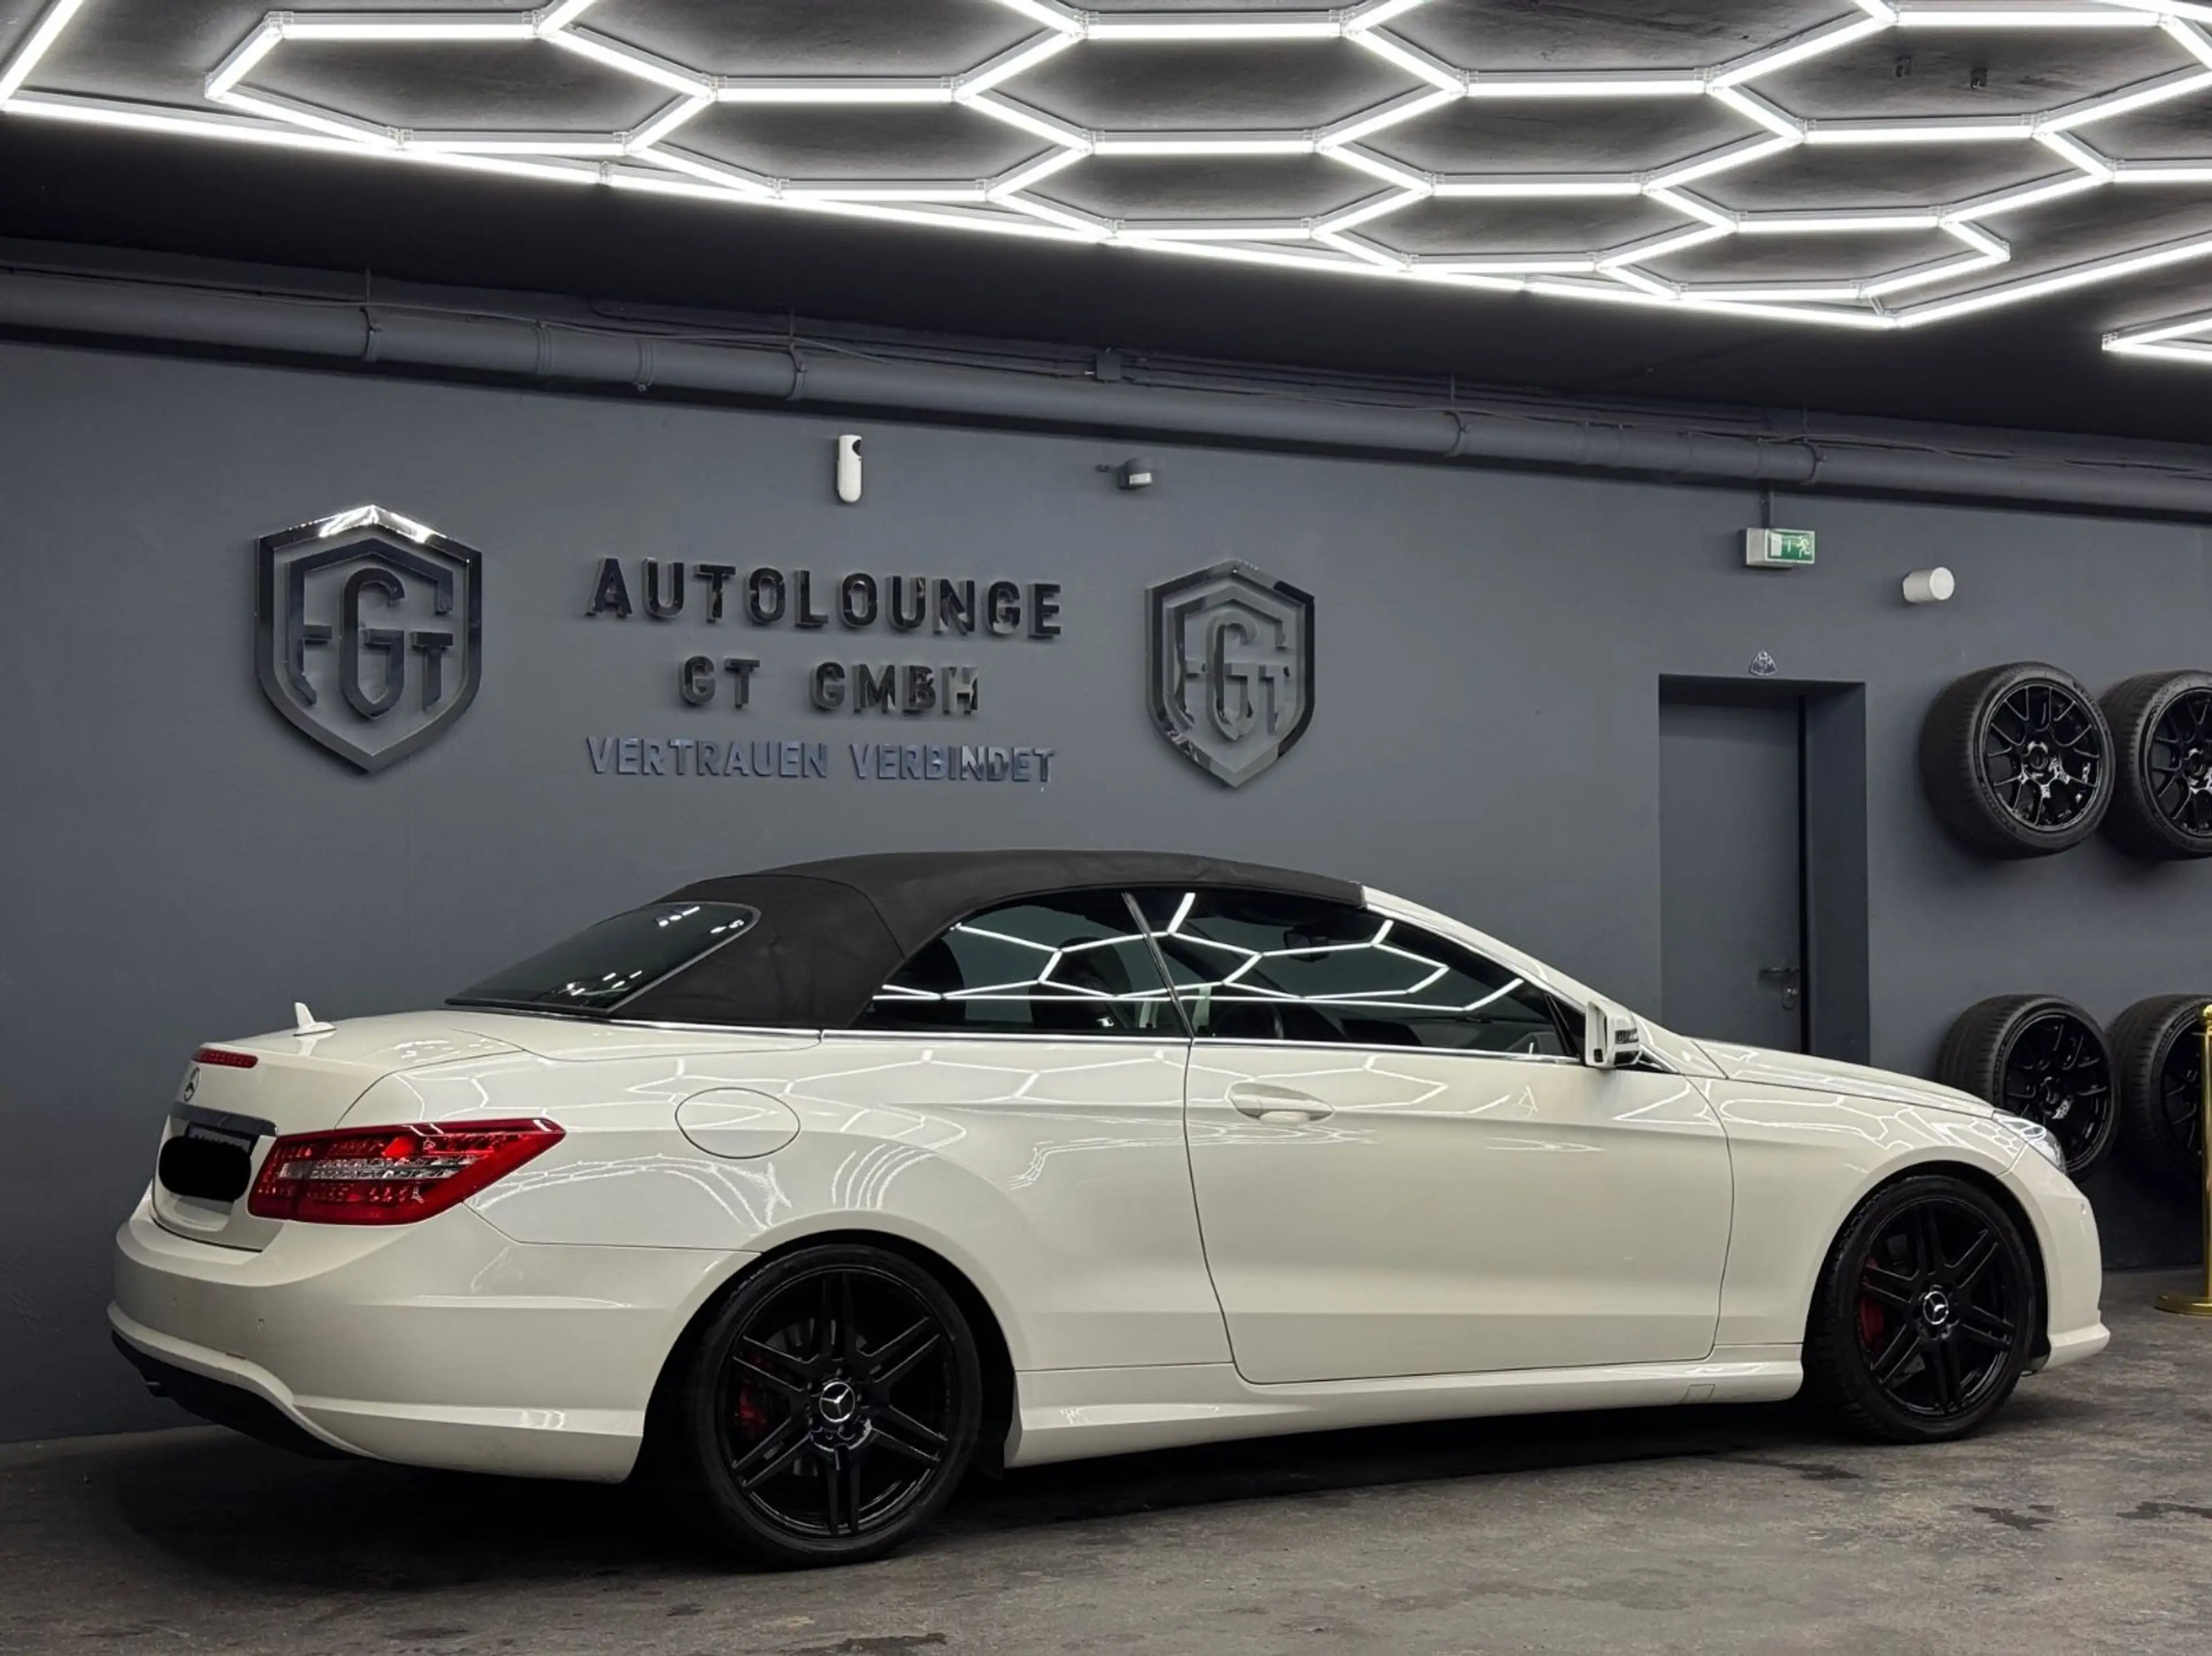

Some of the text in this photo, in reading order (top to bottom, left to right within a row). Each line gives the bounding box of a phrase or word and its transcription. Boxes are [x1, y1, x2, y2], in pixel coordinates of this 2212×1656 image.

[585, 557, 1061, 636] AUTOLOUNGE
[680, 655, 979, 715] GT GMBH
[586, 736, 1055, 783] VERTRAUEN VERBINDET
